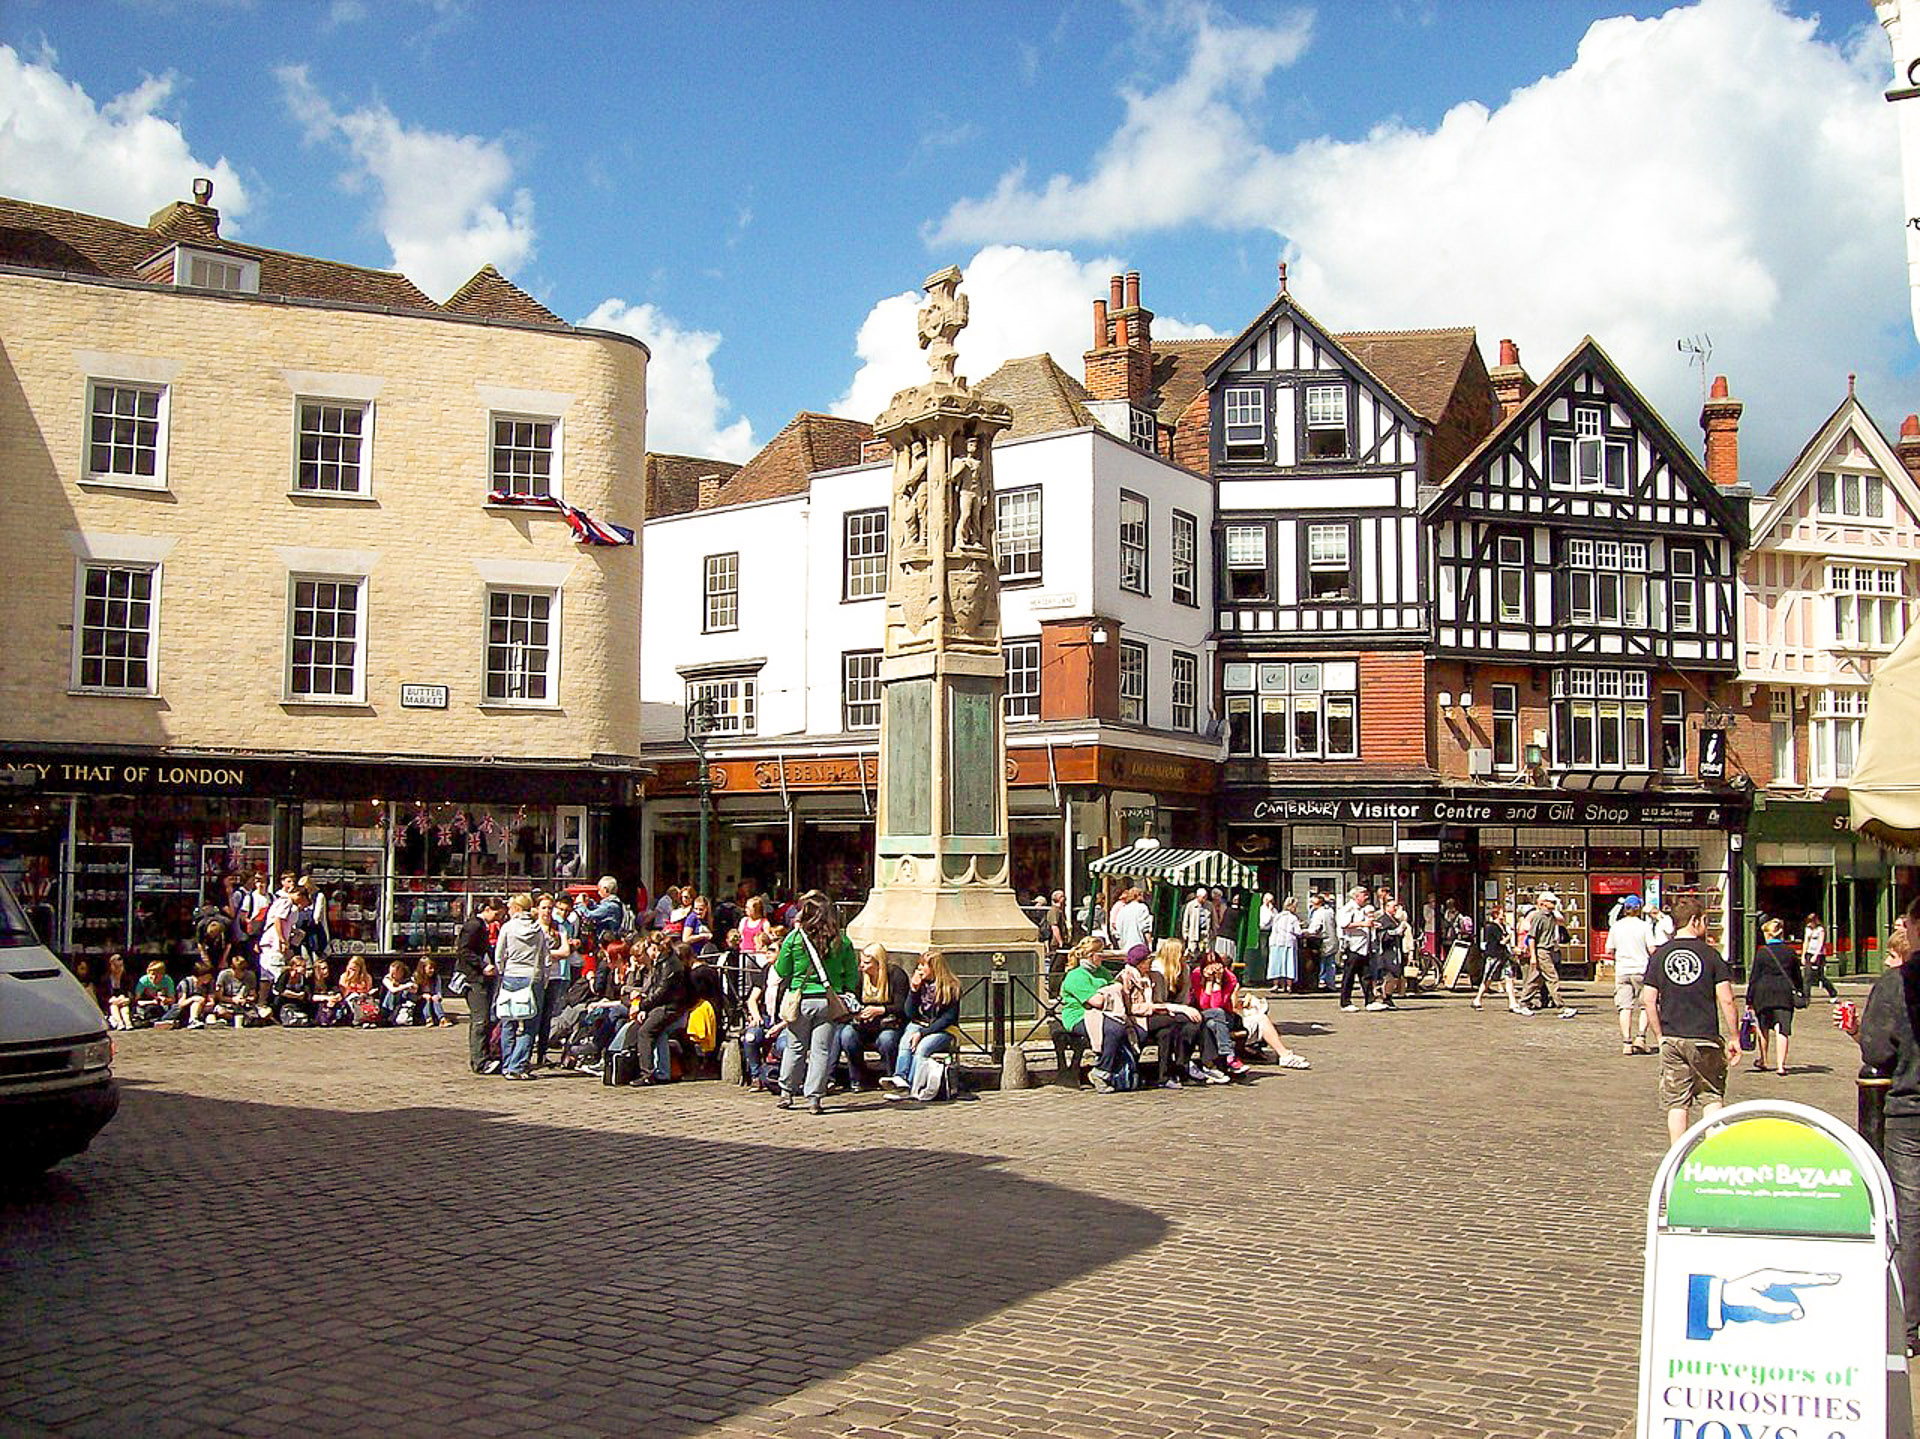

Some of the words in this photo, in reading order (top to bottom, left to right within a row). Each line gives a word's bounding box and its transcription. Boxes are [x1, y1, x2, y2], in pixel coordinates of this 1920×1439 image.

[405, 695, 443, 704] MARKET
[407, 687, 443, 696] BUTTER
[61, 764, 115, 781] THAT
[124, 766, 149, 782] OF
[157, 767, 244, 785] LONDON
[772, 764, 876, 782] DEBENHAMS
[1253, 801, 1341, 820] CANTERBURY
[1350, 802, 1419, 818] Visitor
[1434, 803, 1491, 819] Centre
[1506, 805, 1537, 820] and
[1549, 804, 1574, 820] Gift
[1585, 804, 1629, 823] Shop
[1776, 1163, 1853, 1189] BAZAAR
[1668, 1359, 1815, 1386] purveyors
[1825, 1366, 1859, 1387] of
[1663, 1386, 1861, 1422] CURIOSITIES
